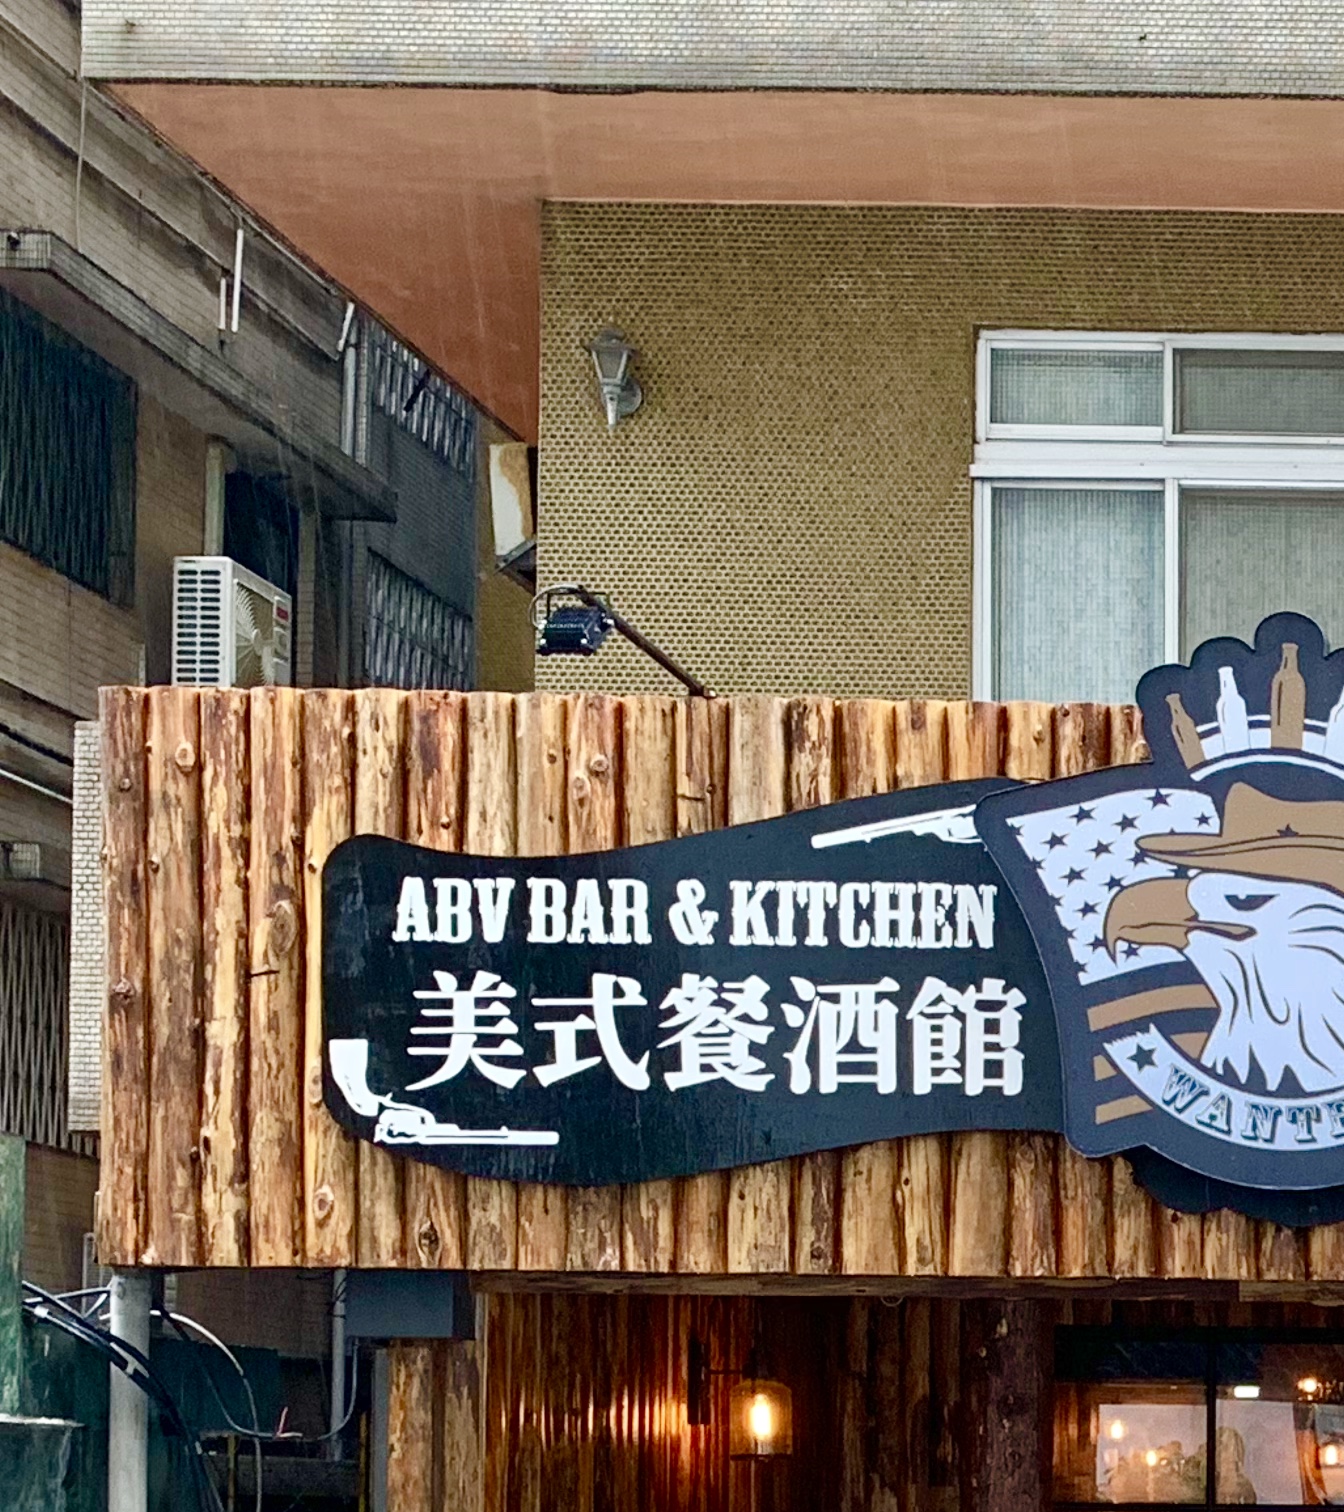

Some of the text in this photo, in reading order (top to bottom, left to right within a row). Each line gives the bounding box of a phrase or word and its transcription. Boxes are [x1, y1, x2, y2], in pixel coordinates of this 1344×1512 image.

[392, 875, 997, 950] ABV BAR & KITCHEN
[404, 968, 1027, 1097] 美式餐酒館
